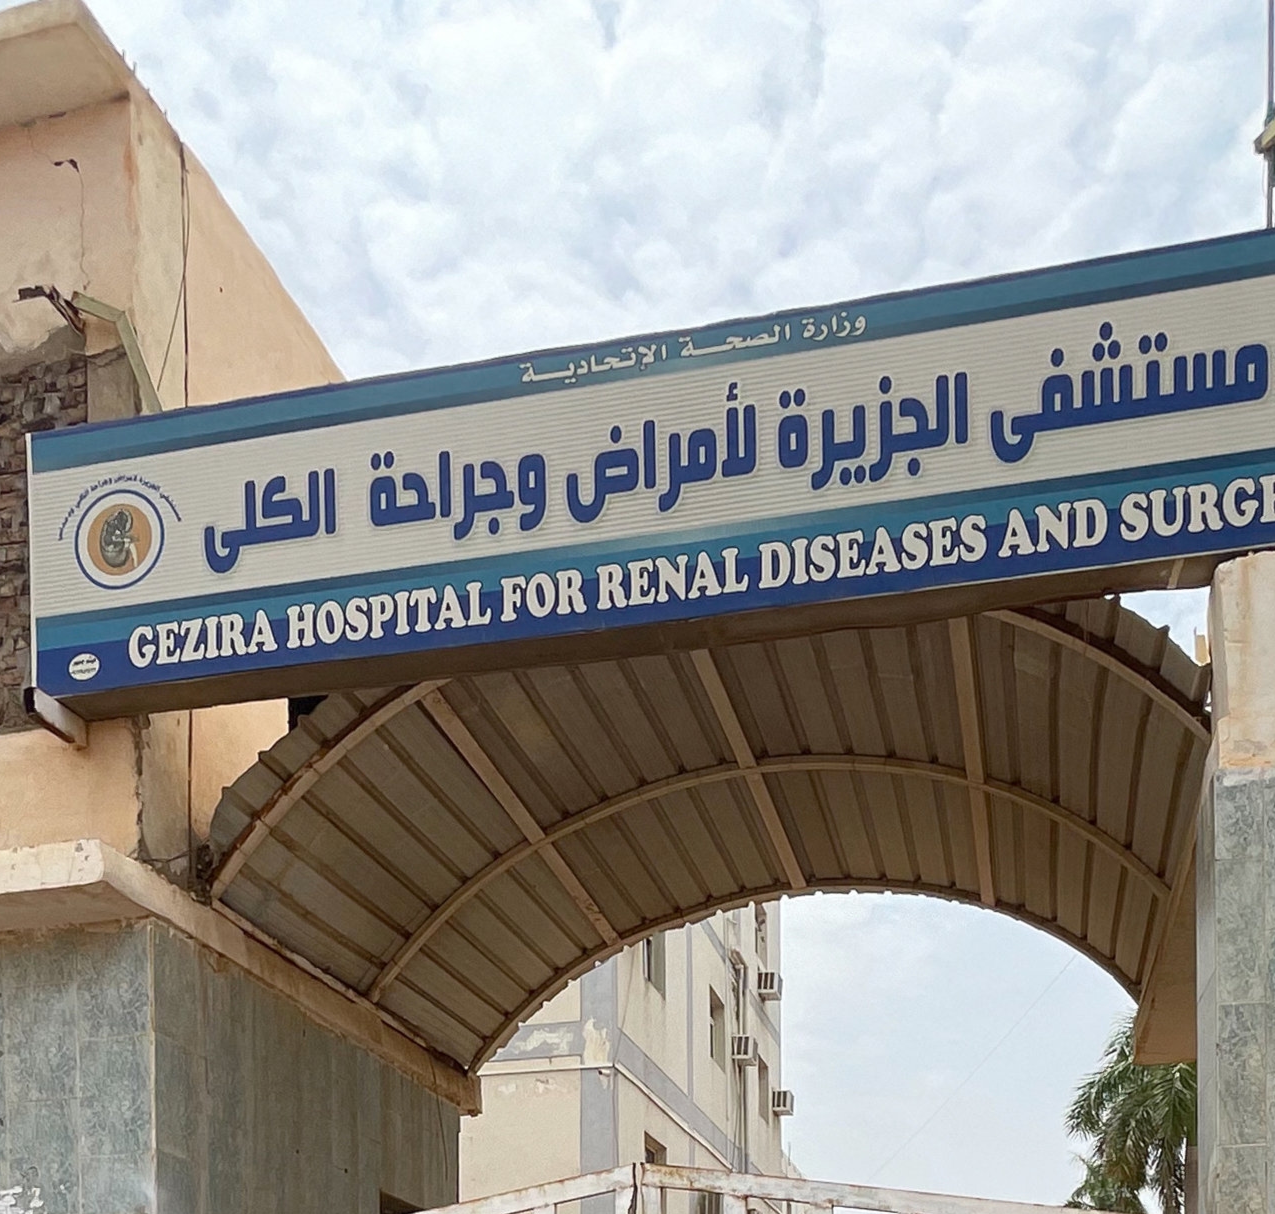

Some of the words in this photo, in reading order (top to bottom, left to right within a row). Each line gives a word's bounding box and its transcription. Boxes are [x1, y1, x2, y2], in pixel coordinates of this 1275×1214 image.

[678, 322, 791, 359] الصحة
[800, 310, 867, 341] وزارة
[777, 371, 969, 491] الجزيرة
[990, 321, 1269, 463] مستشفى
[368, 448, 547, 541] وجراحة
[566, 380, 757, 524] لأمراض
[204, 467, 337, 574] الكلى
[127, 610, 279, 669] GEZIRA
[286, 581, 493, 650] HOSPITAL
[499, 564, 588, 623] FOR
[595, 546, 750, 612] RENAL
[757, 514, 989, 592] DISEASES
[998, 499, 1109, 559] AND
